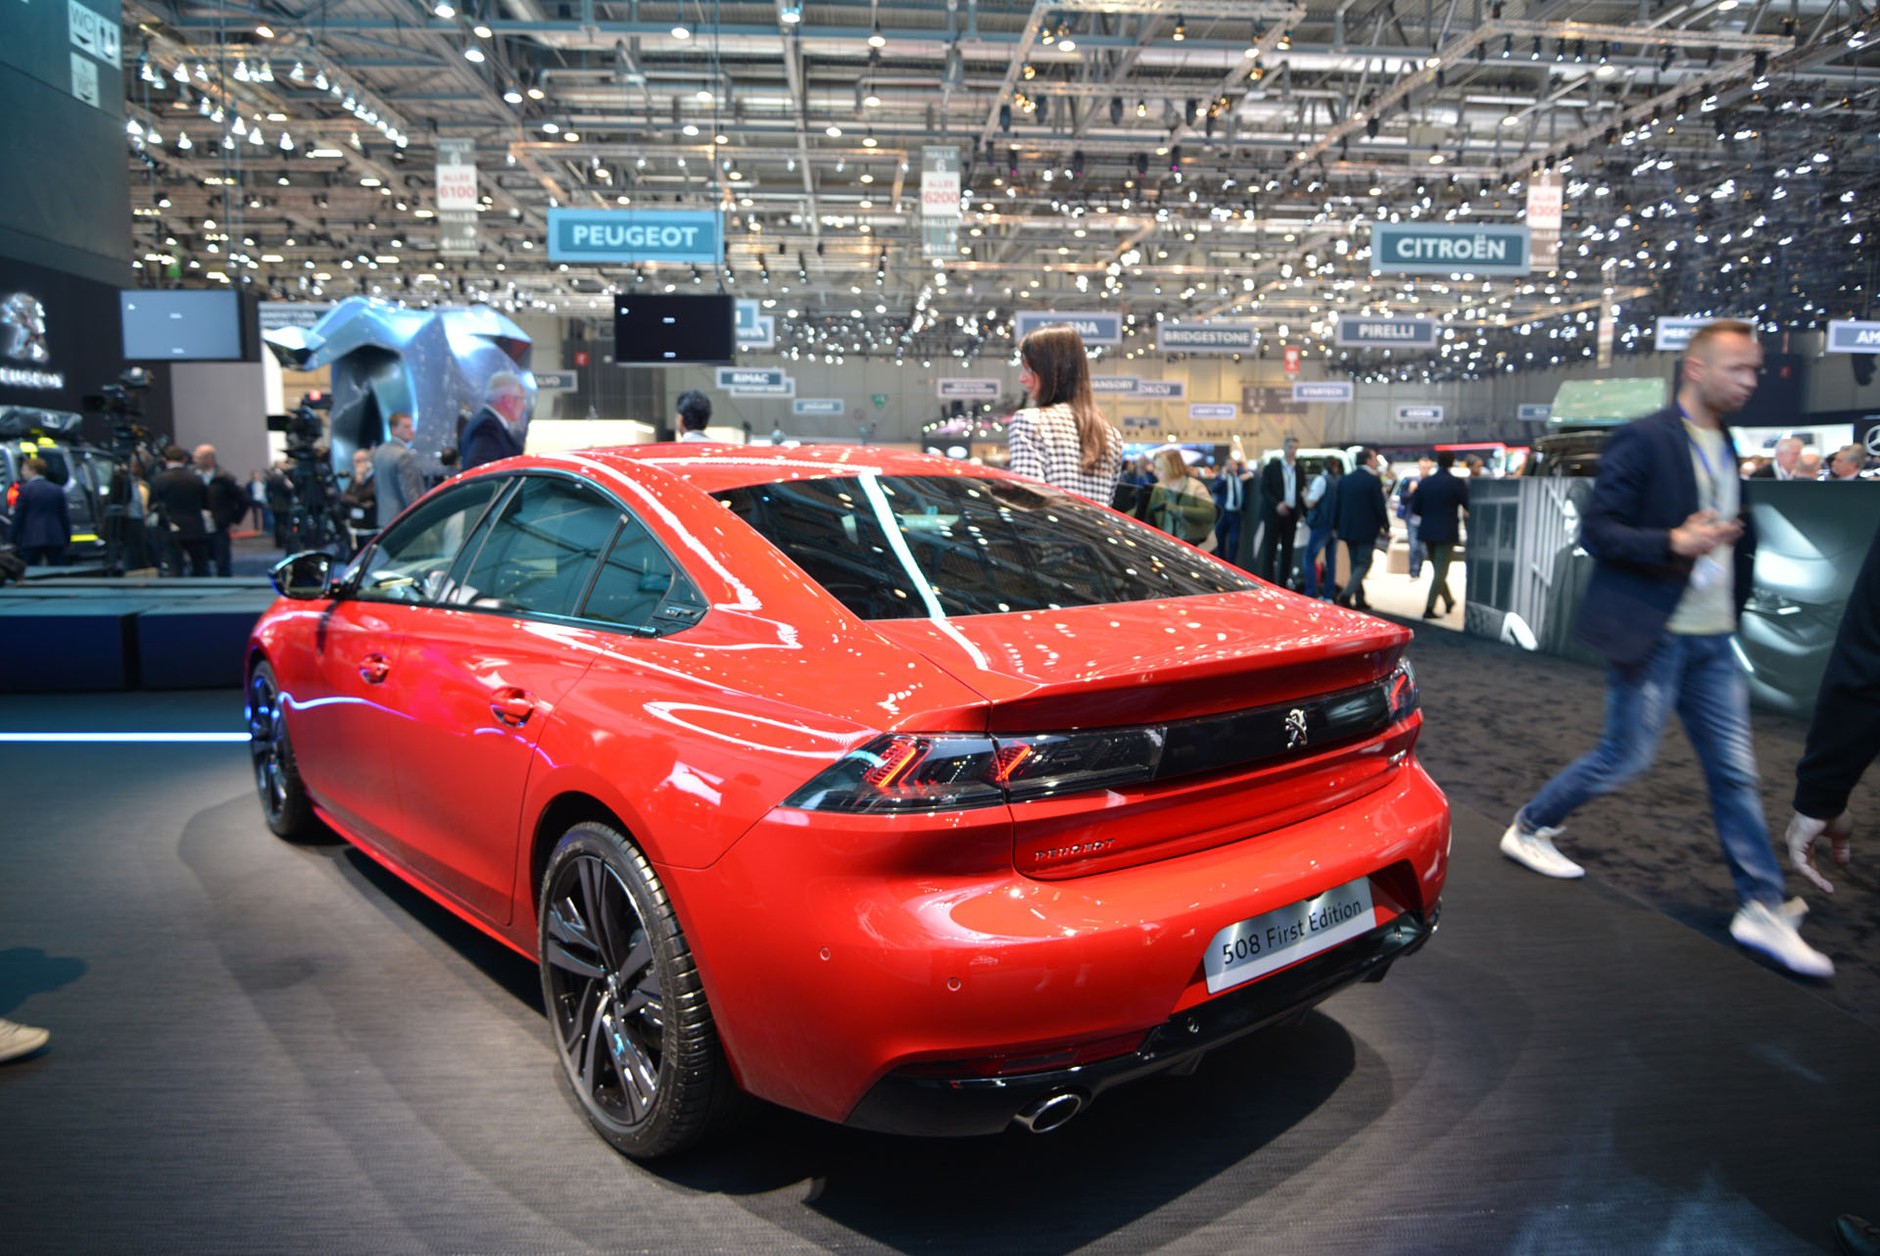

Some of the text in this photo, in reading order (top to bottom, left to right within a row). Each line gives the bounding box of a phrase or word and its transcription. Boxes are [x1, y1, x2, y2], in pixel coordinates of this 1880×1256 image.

[71, 6, 93, 33] WC
[440, 185, 476, 198] 6100
[924, 191, 960, 204] 6200
[573, 225, 699, 248] PEUGEOT
[1396, 234, 1506, 260] CITROËN
[1164, 331, 1250, 344] BRIDGESTONE
[1358, 324, 1416, 339] PIRELLI
[0, 367, 64, 389] EUGEOT
[733, 373, 770, 384] RIMAC
[1034, 838, 1116, 861] PEUGEOT
[1223, 900, 1362, 965] 508 First Edition
